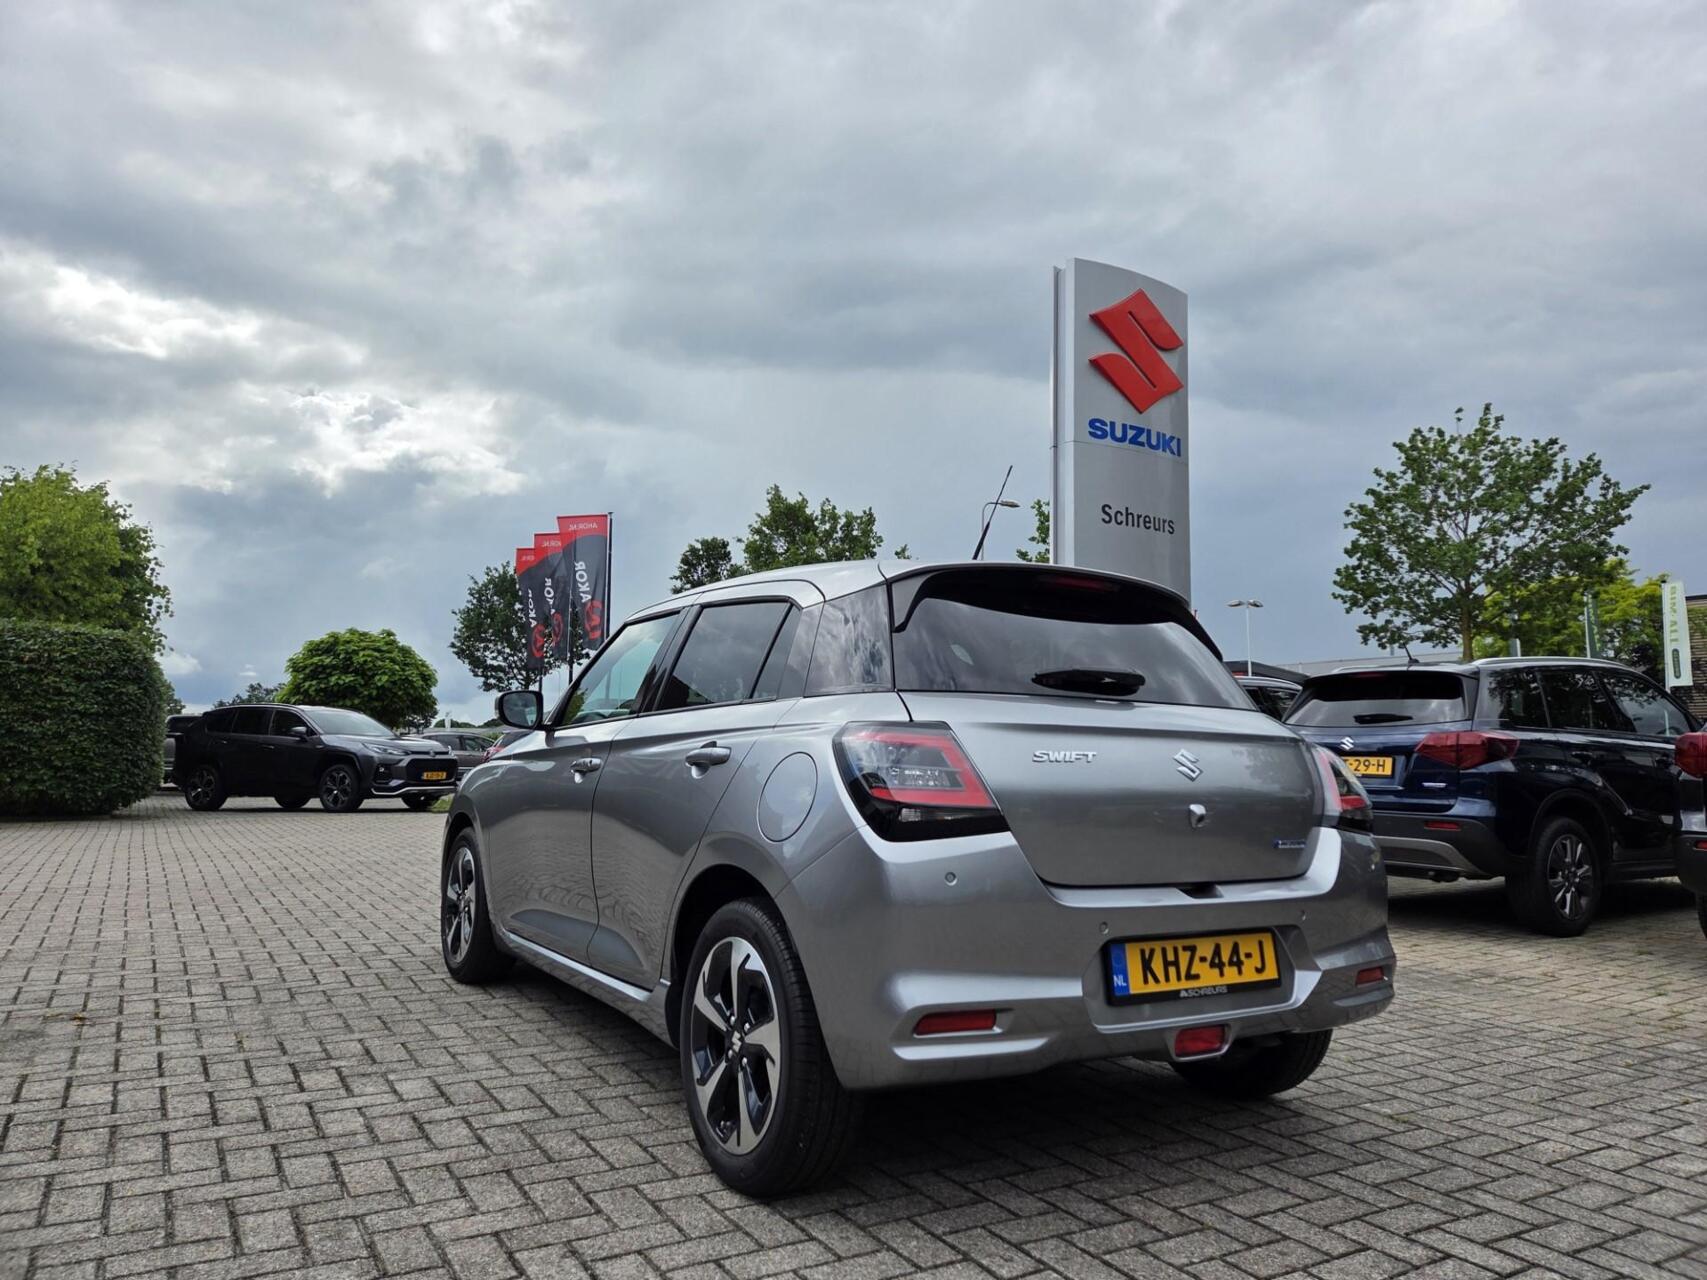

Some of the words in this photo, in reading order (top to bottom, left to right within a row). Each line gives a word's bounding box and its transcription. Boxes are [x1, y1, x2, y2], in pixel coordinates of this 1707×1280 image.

[1088, 418, 1181, 457] SUZUKI
[1101, 504, 1175, 534] Schreurs
[1032, 750, 1097, 763] SWIFT
[1139, 939, 1267, 985] KHZ-44-J
[1112, 975, 1128, 987] NL
